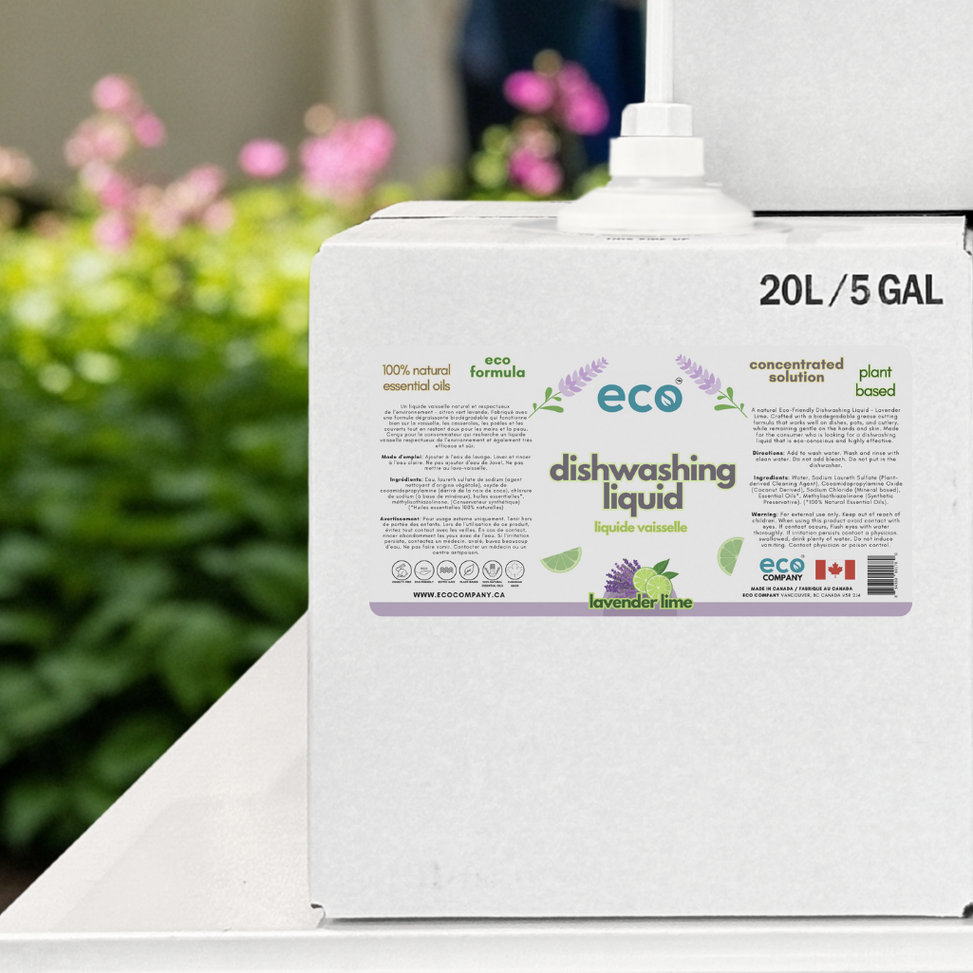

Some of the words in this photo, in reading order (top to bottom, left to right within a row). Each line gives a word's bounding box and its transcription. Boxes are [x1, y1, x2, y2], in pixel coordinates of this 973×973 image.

[878, 274, 943, 305] GAL
[484, 356, 511, 366] eco
[749, 357, 844, 370] concentrated
[382, 364, 410, 376] 100%
[413, 363, 451, 376] natural
[470, 365, 525, 378] formula
[768, 370, 825, 383] solution
[859, 364, 893, 382] plant
[383, 379, 430, 391] essential
[432, 379, 451, 391] oils
[855, 382, 896, 397] based
[597, 382, 683, 413] eco
[549, 453, 737, 490] dishwashing
[602, 481, 684, 518] liquid
[594, 520, 635, 536] liquide
[636, 520, 688, 533] vaisselle
[759, 557, 805, 574] eco
[763, 573, 803, 582] COMPANY
[588, 592, 657, 610] lavender
[658, 592, 694, 610] lime
